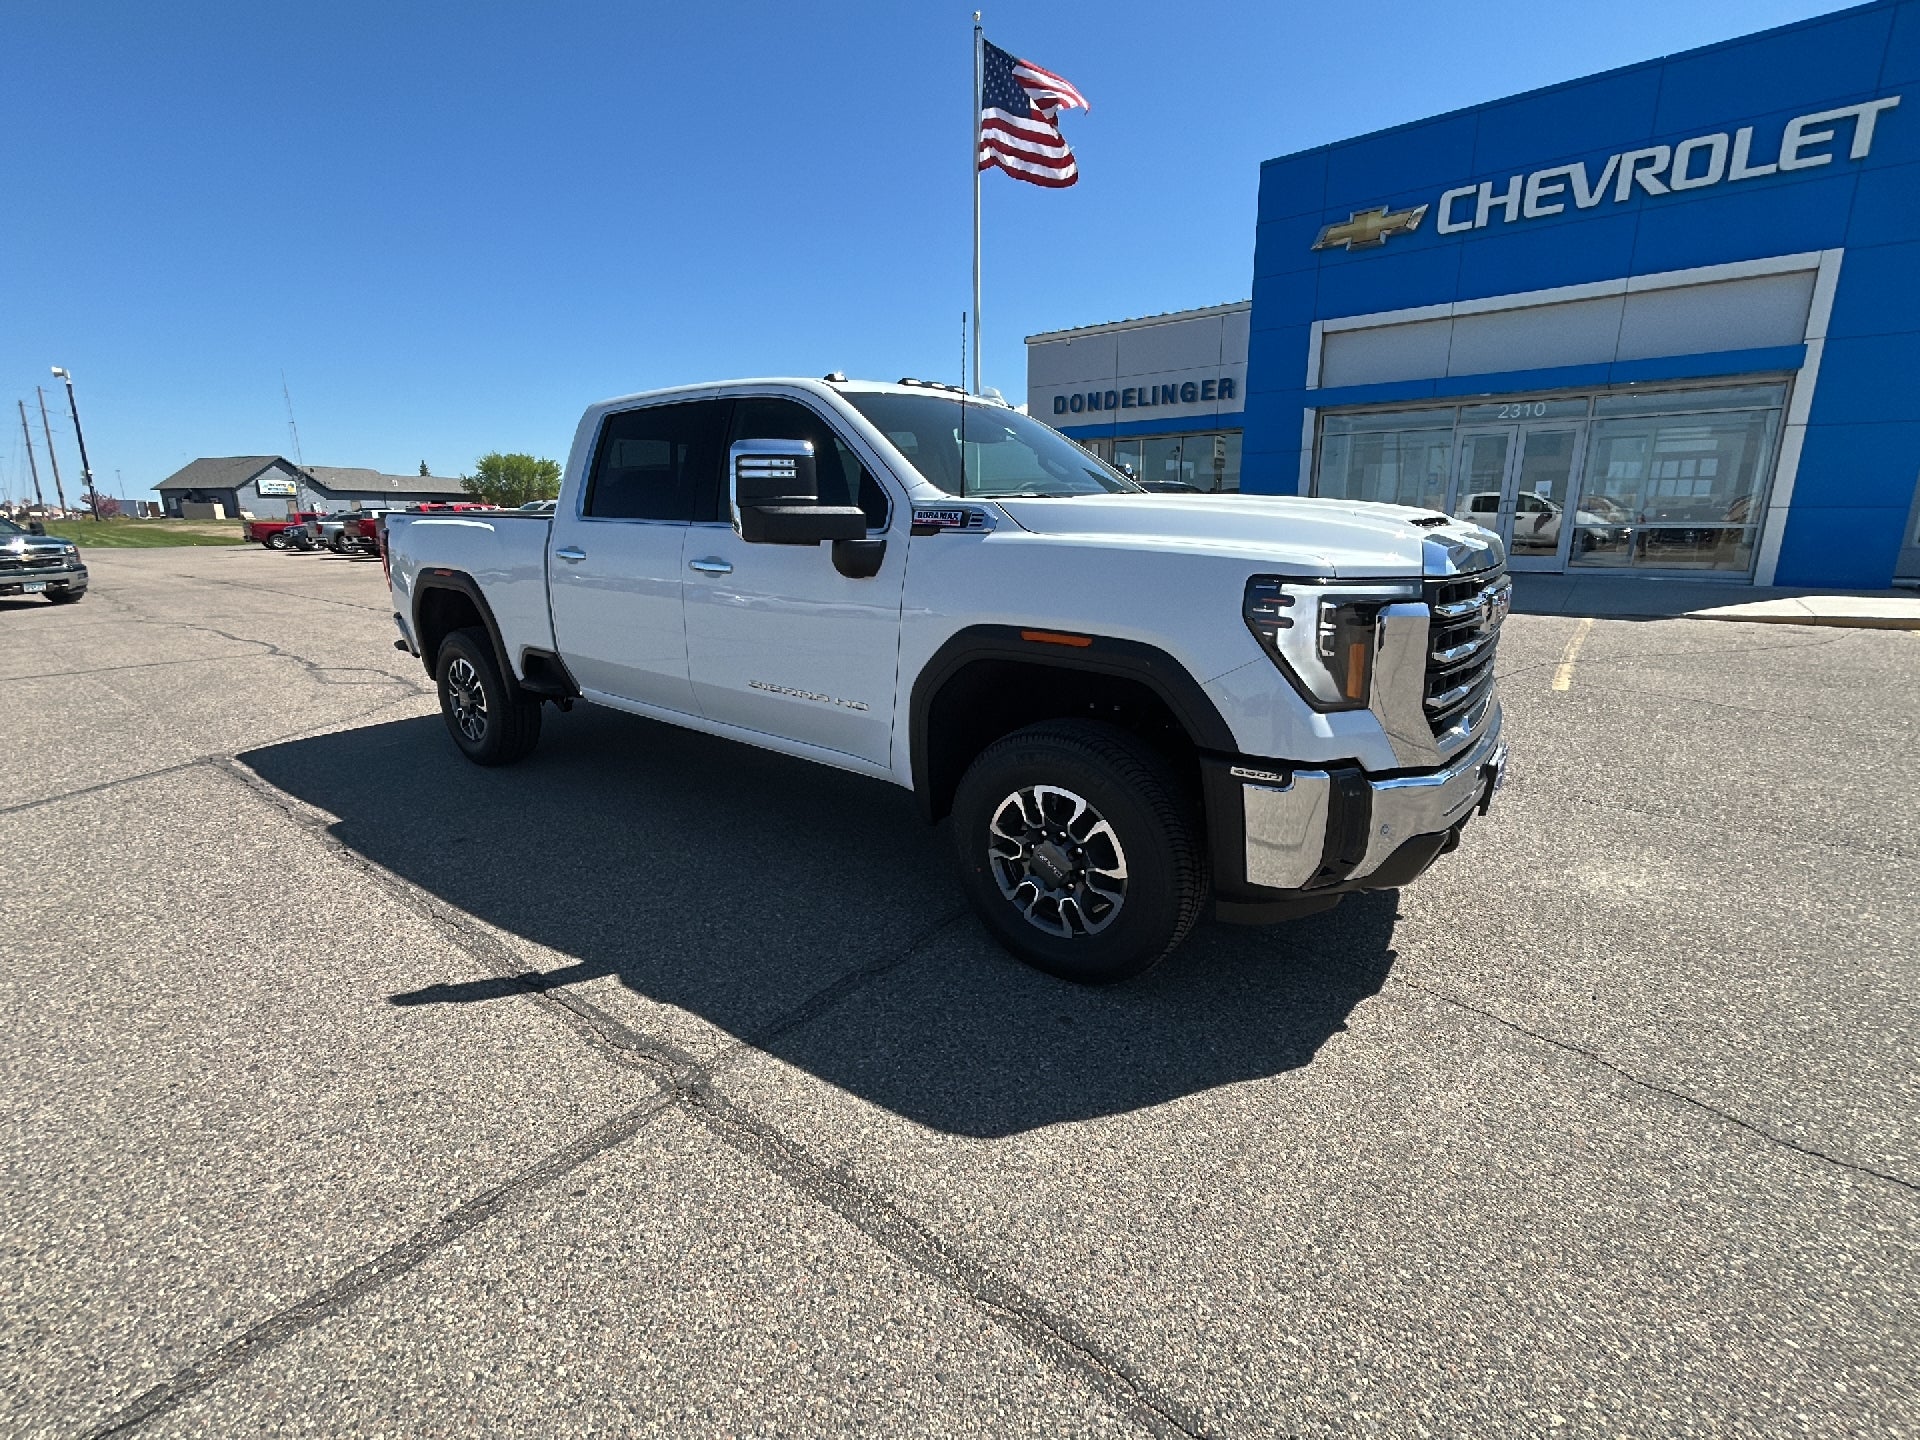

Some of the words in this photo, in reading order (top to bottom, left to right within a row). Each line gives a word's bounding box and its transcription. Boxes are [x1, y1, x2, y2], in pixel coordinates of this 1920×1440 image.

[1437, 95, 1902, 235] CHEVROLET
[1053, 377, 1236, 415] DONDELINGER
[1497, 402, 1546, 419] 2310
[916, 510, 960, 521] DURAMAX
